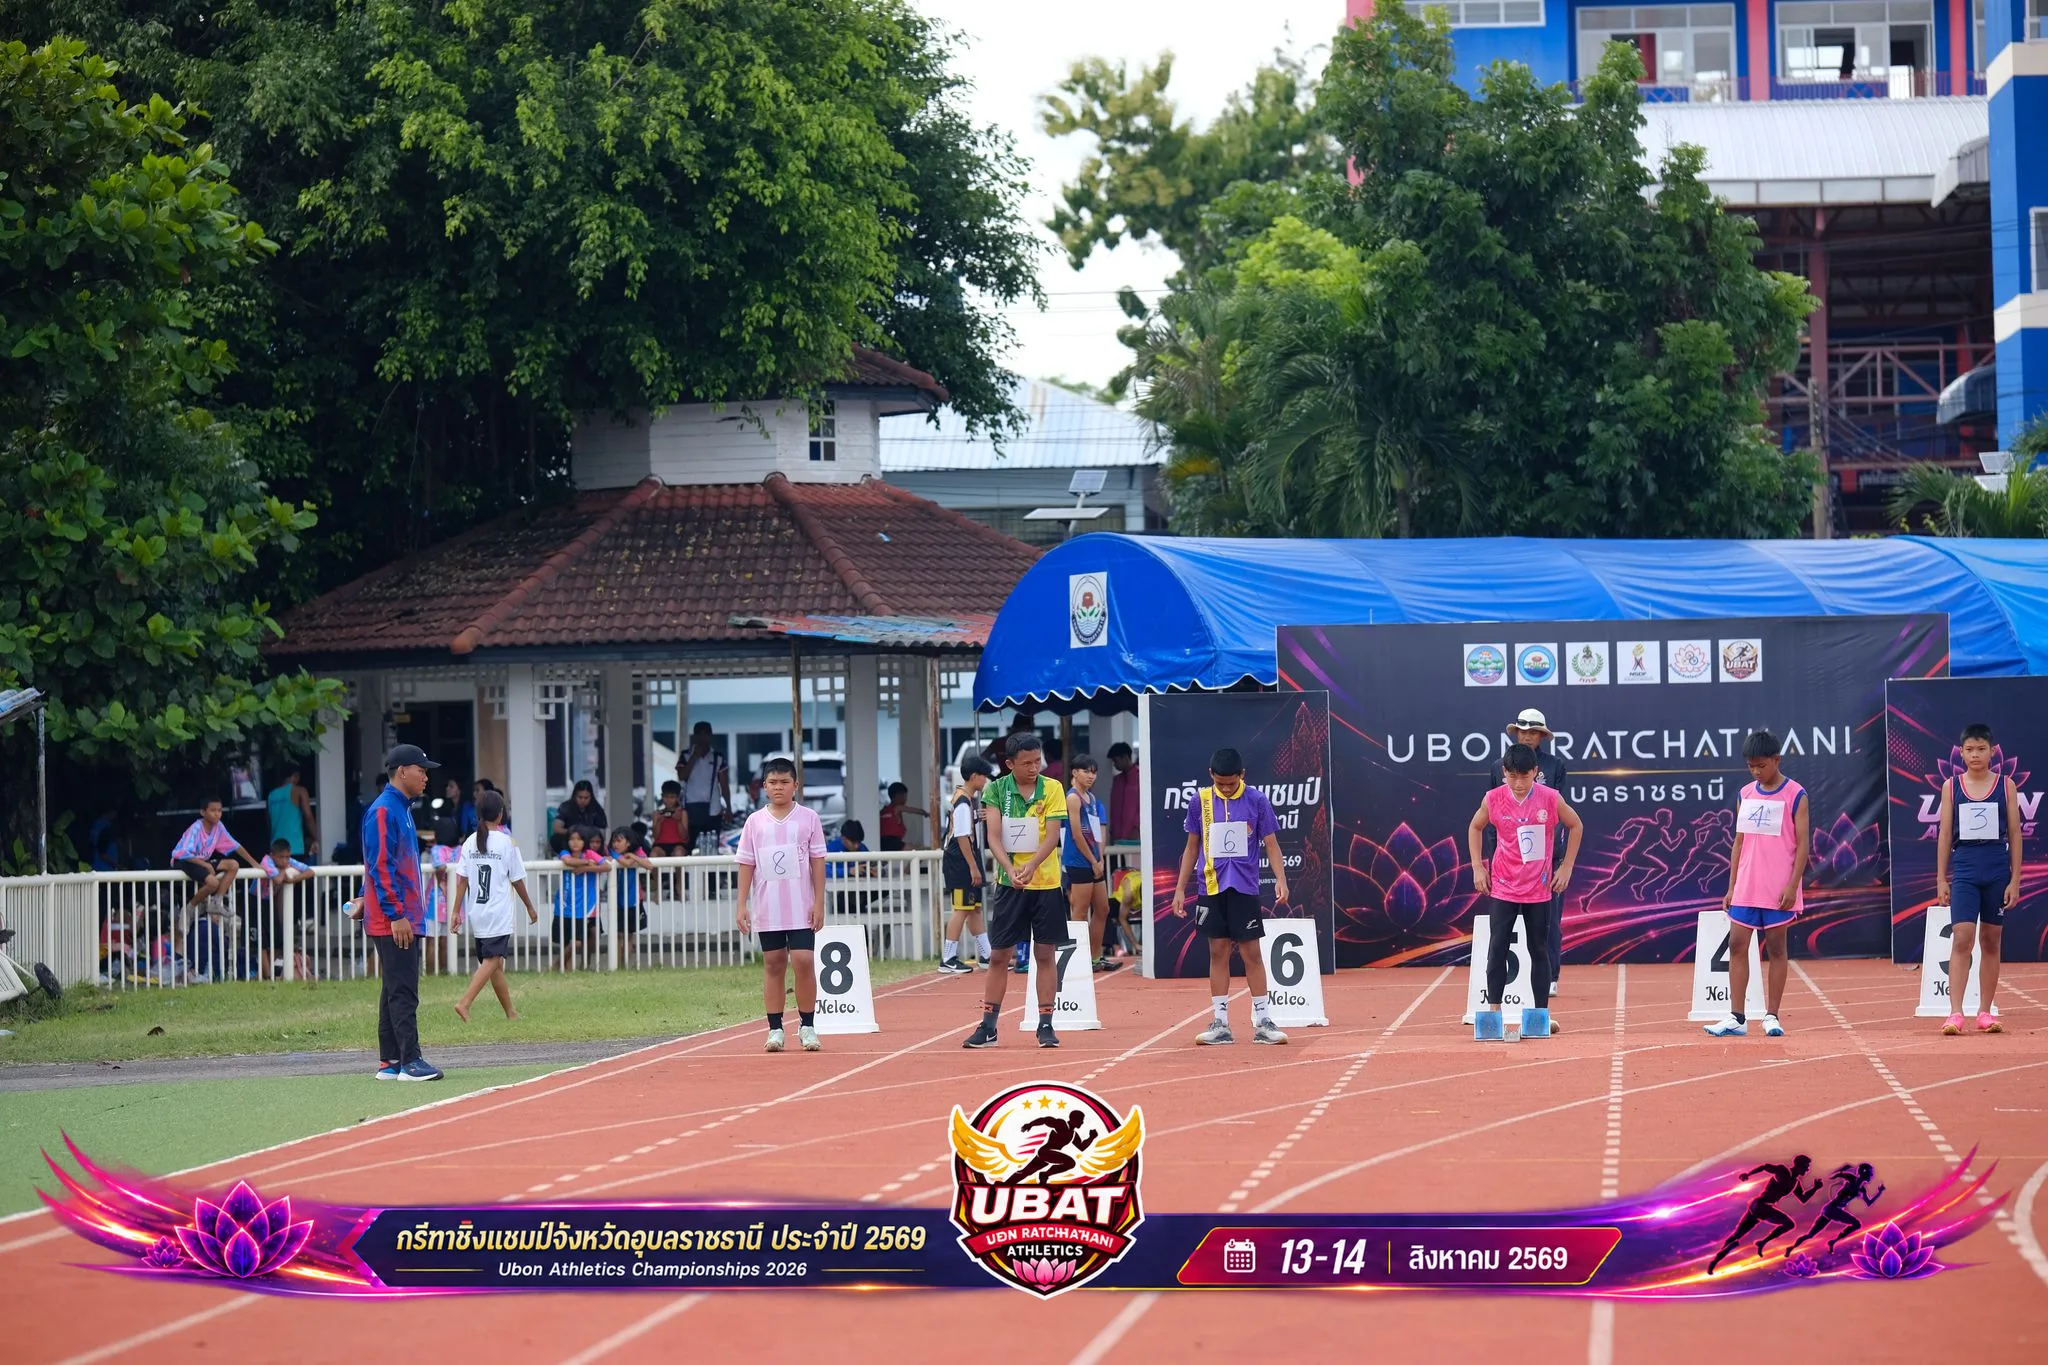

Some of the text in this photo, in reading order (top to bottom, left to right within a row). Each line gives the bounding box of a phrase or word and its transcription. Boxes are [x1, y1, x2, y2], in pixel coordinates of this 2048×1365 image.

[1550, 726, 1851, 760] RATCHATANI
[1748, 805, 1770, 828] 4
[1970, 808, 1988, 830] 3
[1010, 824, 1026, 846] 7
[1224, 829, 1236, 853] 6
[1520, 831, 1534, 855] 5
[772, 850, 786, 875] 8
[1281, 854, 1303, 868] 569
[476, 863, 492, 904] 9
[819, 941, 854, 995] 8
[1055, 938, 1078, 993] 7
[1270, 932, 1305, 987] 6
[1267, 990, 1306, 1006] Nelco
[1705, 985, 1730, 1001] Nel
[815, 999, 856, 1015] Nelco
